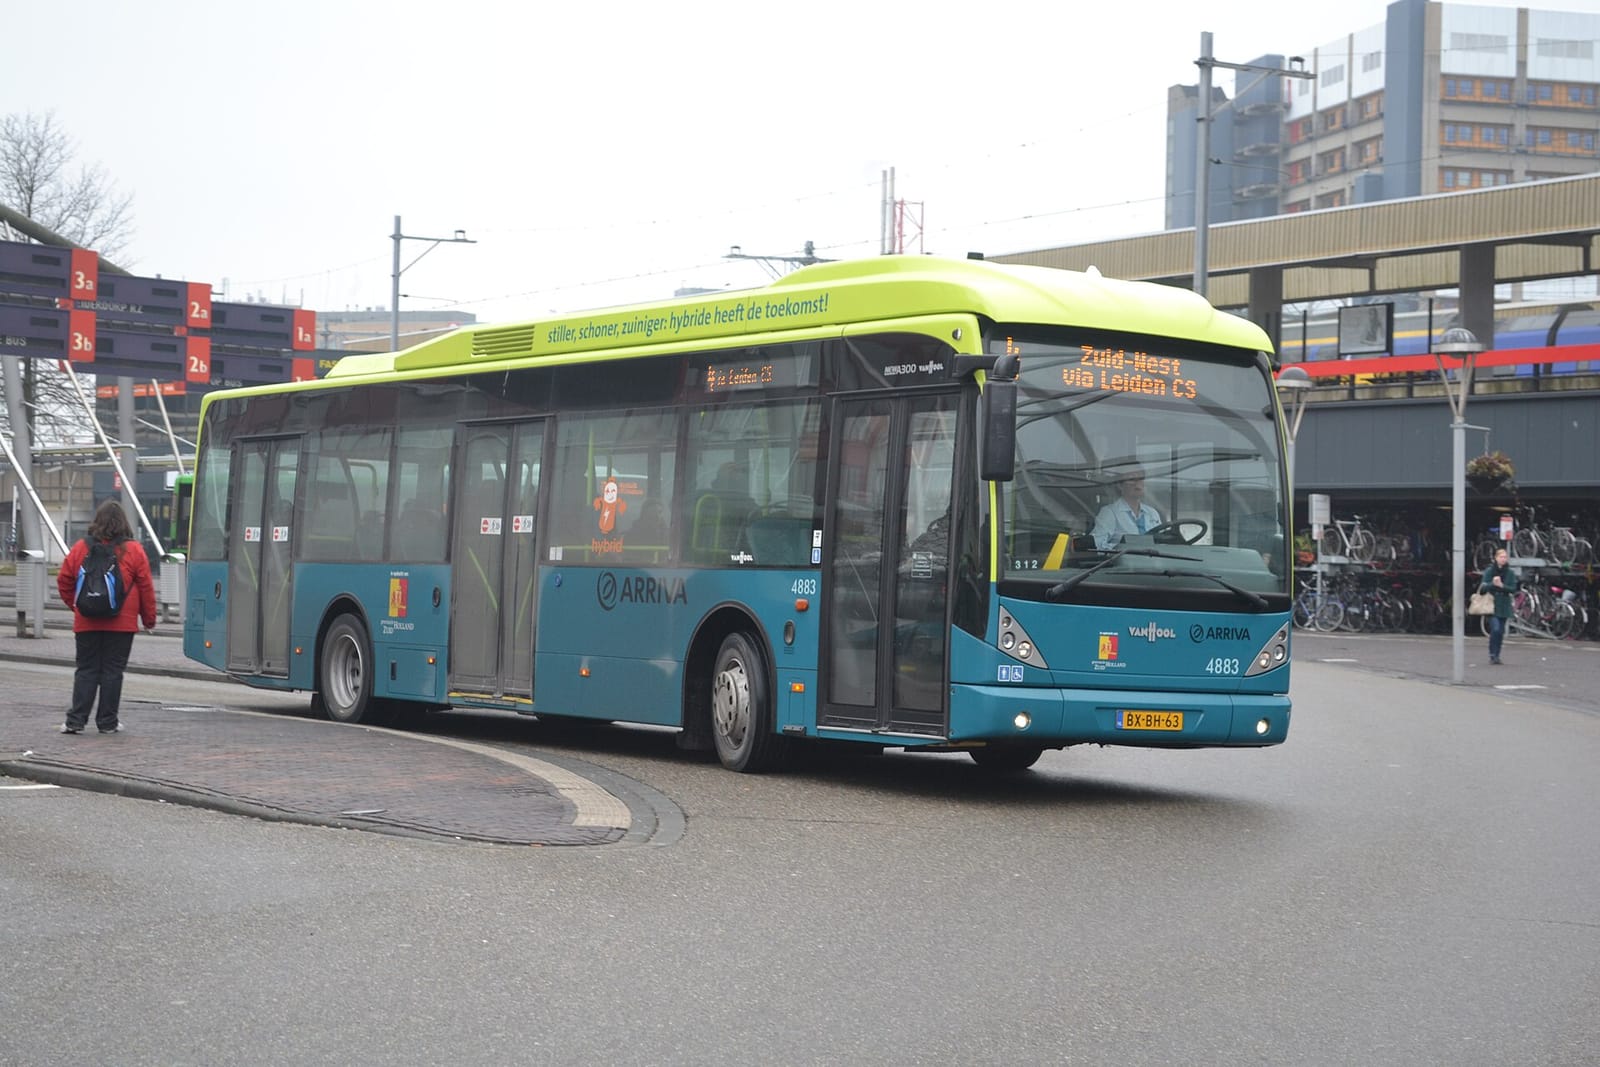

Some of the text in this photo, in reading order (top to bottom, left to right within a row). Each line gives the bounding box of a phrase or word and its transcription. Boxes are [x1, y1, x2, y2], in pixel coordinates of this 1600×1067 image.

[74, 271, 94, 291] 3a
[190, 301, 208, 319] 2a
[547, 292, 829, 343] stiller, schoner, zuiniger: hybride heeft de toekomst!
[5, 336, 27, 347] BUS
[72, 332, 92, 351] 3b
[297, 327, 311, 343] 1a
[189, 356, 208, 374] 2b
[1062, 367, 1198, 399] via Leiden CS
[592, 537, 624, 556] hybrid
[620, 576, 689, 605] ARRIVA
[791, 578, 817, 595] 4883
[1206, 626, 1251, 641] ARRIVA
[1205, 657, 1240, 675] 4883
[1126, 712, 1179, 728] BX-BH-63
